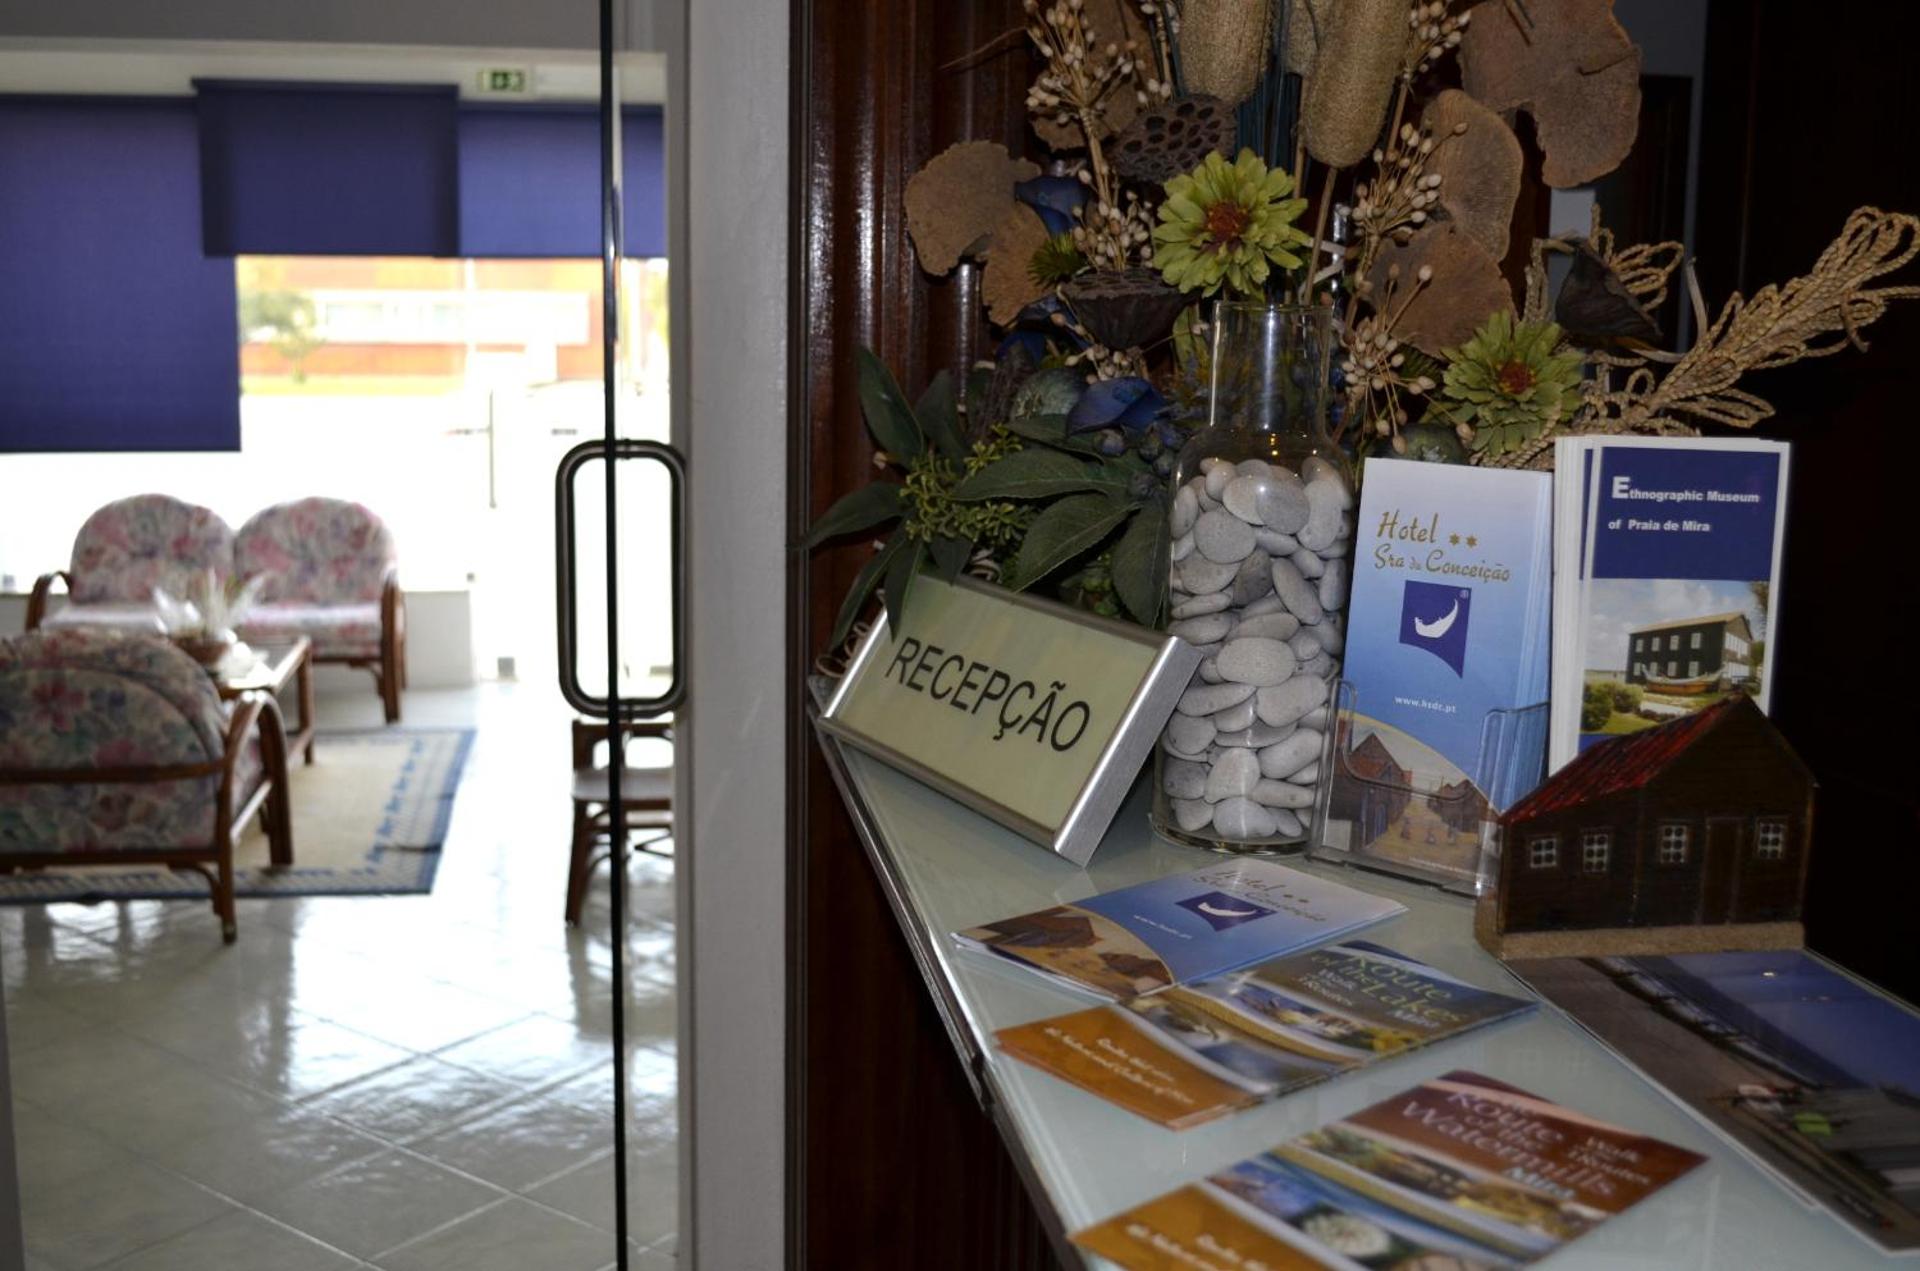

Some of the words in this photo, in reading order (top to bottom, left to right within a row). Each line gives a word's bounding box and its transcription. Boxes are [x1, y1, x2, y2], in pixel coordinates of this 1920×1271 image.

[1612, 476, 1703, 502] Ethnographic
[1707, 491, 1760, 502] Museum
[1377, 509, 1439, 543] Hotel
[1608, 519, 1622, 530] of
[1628, 519, 1660, 531] Praia
[1663, 520, 1679, 531] de
[1682, 520, 1711, 532] Mira
[1374, 543, 1404, 569] Sra
[1425, 549, 1511, 583] Conceição
[885, 636, 1091, 751] RECEPÇÃO
